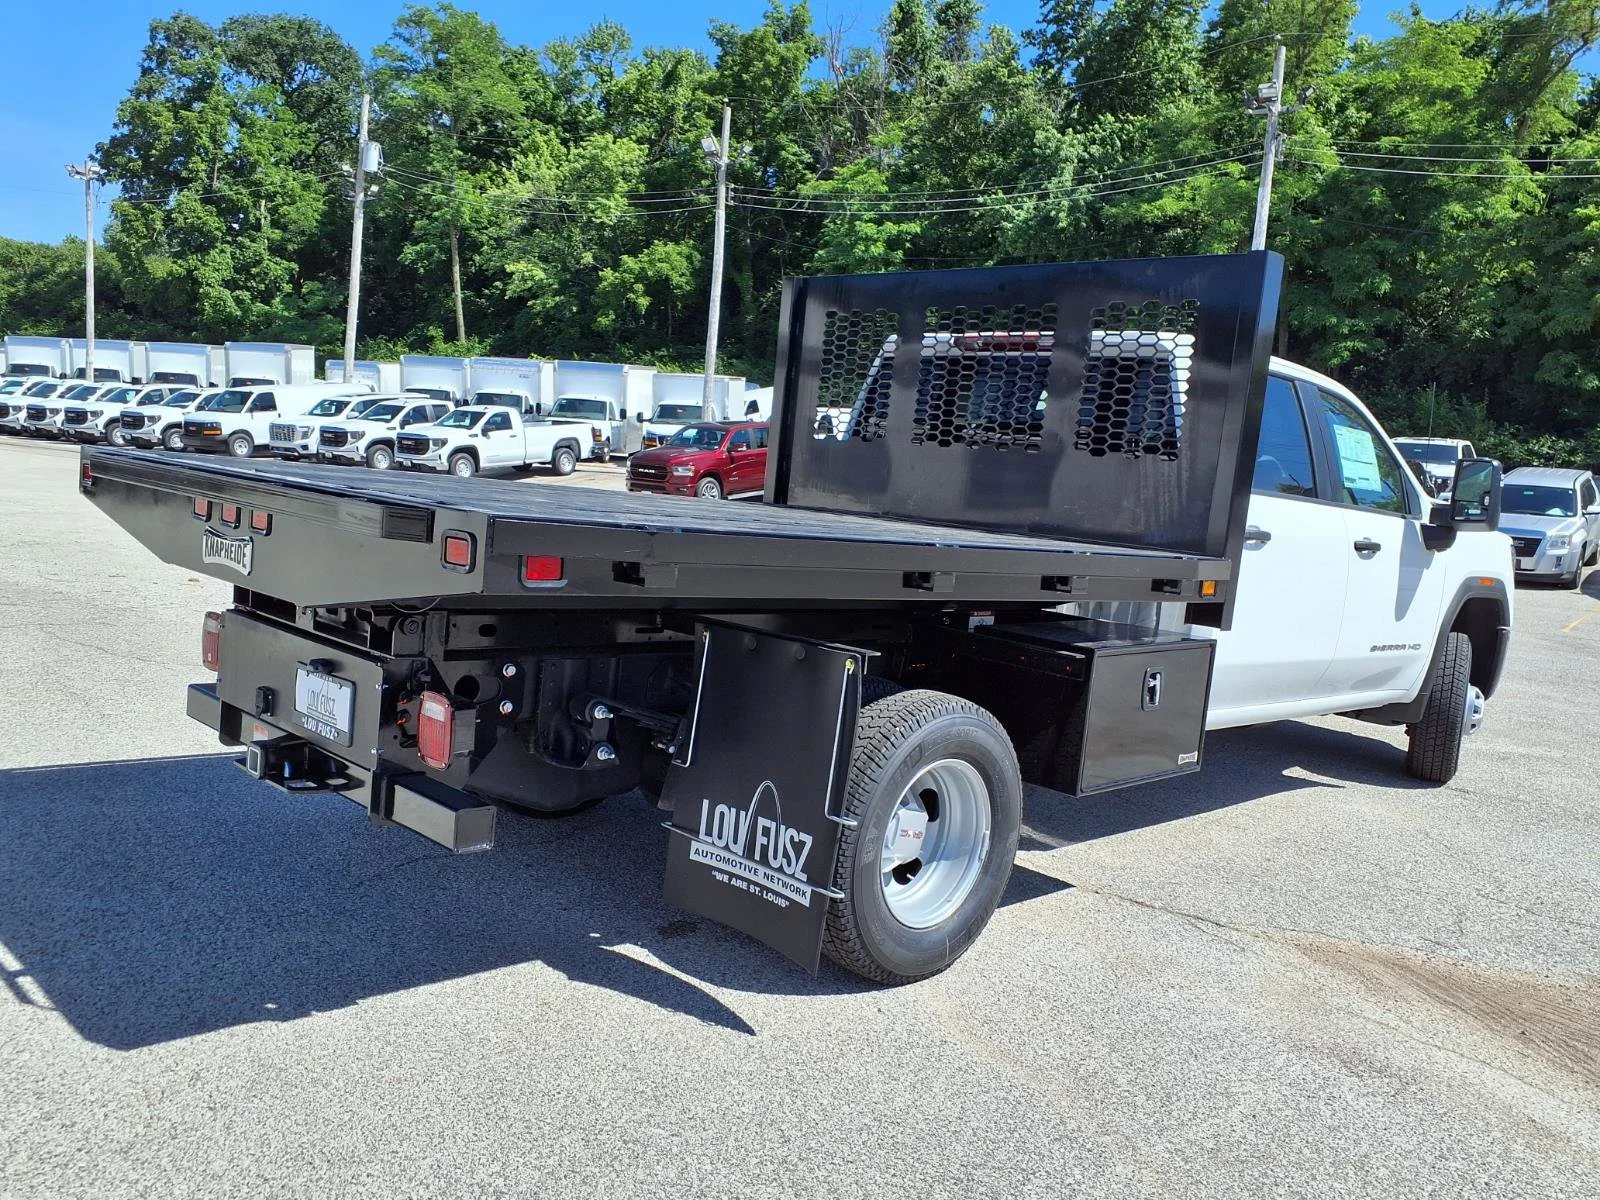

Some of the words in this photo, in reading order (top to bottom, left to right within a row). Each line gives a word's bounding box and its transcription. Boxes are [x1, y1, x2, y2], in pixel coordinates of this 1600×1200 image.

[204, 534, 249, 570] KNAPHEIDE
[1369, 643, 1407, 653] SIERRA
[1408, 643, 1422, 651] HD
[307, 688, 319, 711] LOU
[319, 695, 336, 717] FUSZ
[304, 716, 317, 731] LOU
[317, 722, 336, 740] FUSZ
[698, 798, 749, 857] LOU
[754, 815, 813, 882] FUSZ
[693, 847, 760, 878] AUTOMOTIVE
[763, 871, 808, 900] NETWORK
[730, 877, 748, 891] ARE
[749, 884, 762, 897] ST.
